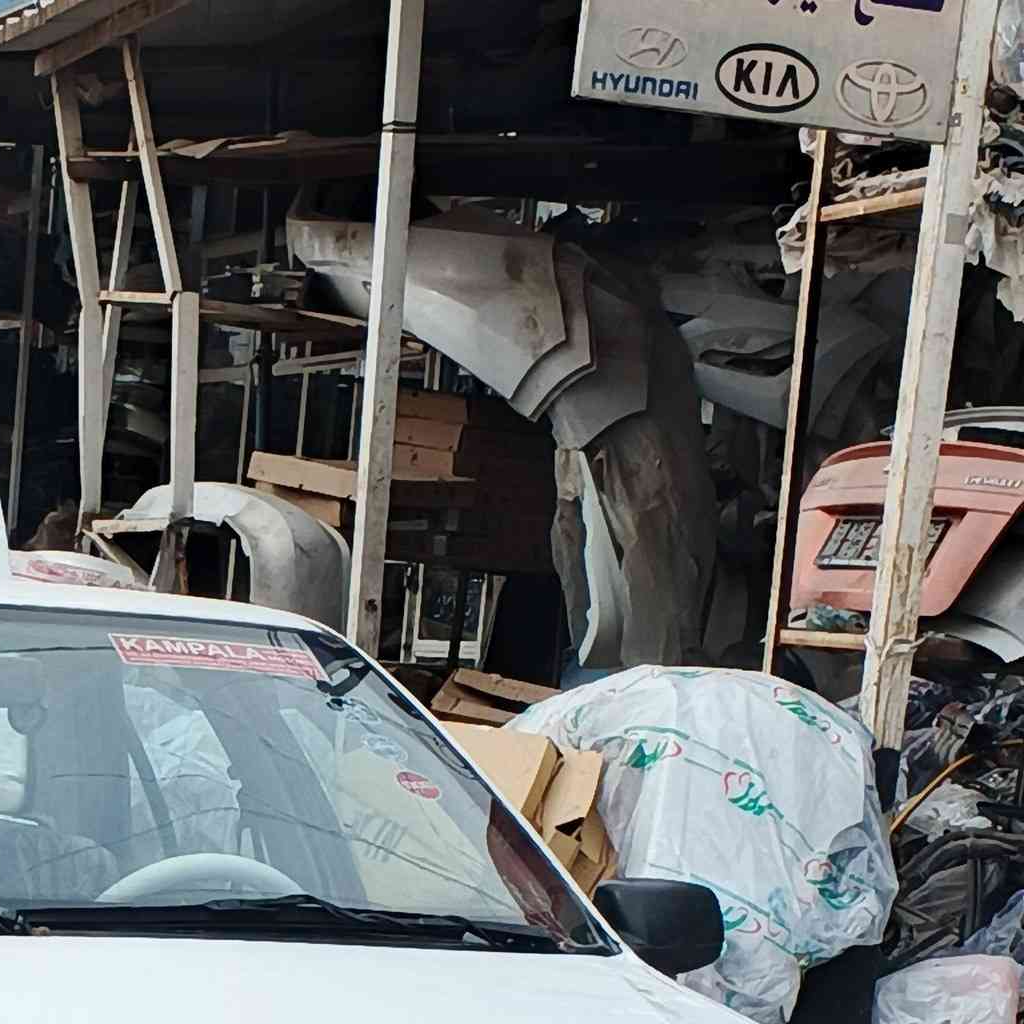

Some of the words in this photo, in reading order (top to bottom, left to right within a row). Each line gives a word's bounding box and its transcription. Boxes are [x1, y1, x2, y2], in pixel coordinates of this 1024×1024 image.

[590, 71, 699, 101] HYUNDAI
[733, 57, 801, 100] KIA
[118, 637, 268, 661] KAMPALA
